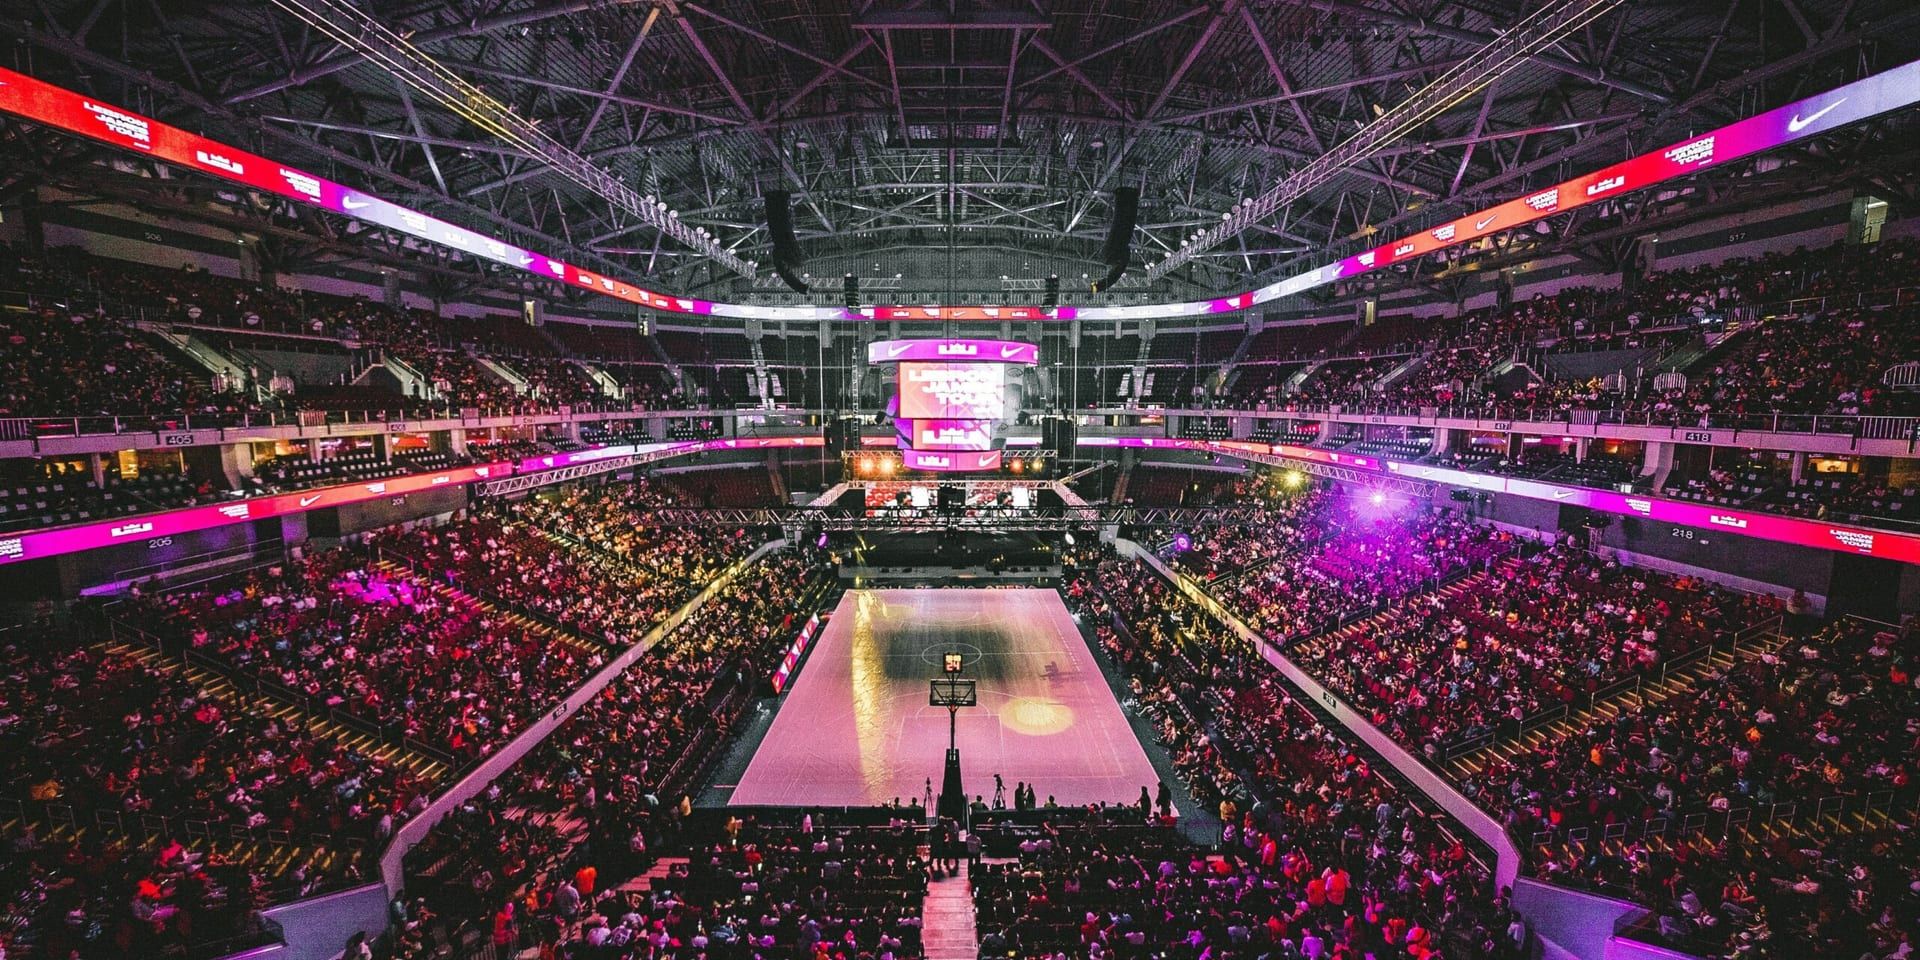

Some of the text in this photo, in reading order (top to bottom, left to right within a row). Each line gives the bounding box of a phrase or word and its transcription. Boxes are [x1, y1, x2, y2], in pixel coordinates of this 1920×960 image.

[84, 101, 148, 128] LEBRON
[95, 114, 149, 135] JAMES
[106, 123, 149, 142] TOUR
[1665, 136, 1714, 158] LEBRON
[1672, 143, 1713, 161] JAMES
[1679, 149, 1713, 165] TOUR
[1729, 232, 1746, 242] 517
[169, 435, 192, 445] 405
[1687, 433, 1709, 442] 418
[1672, 528, 1694, 540] 218
[1830, 529, 1873, 540] LEBRON
[1836, 535, 1873, 544] JAMES
[148, 536, 172, 549] 205
[1843, 540, 1872, 549] TOUR
[946, 661, 961, 671] 24
